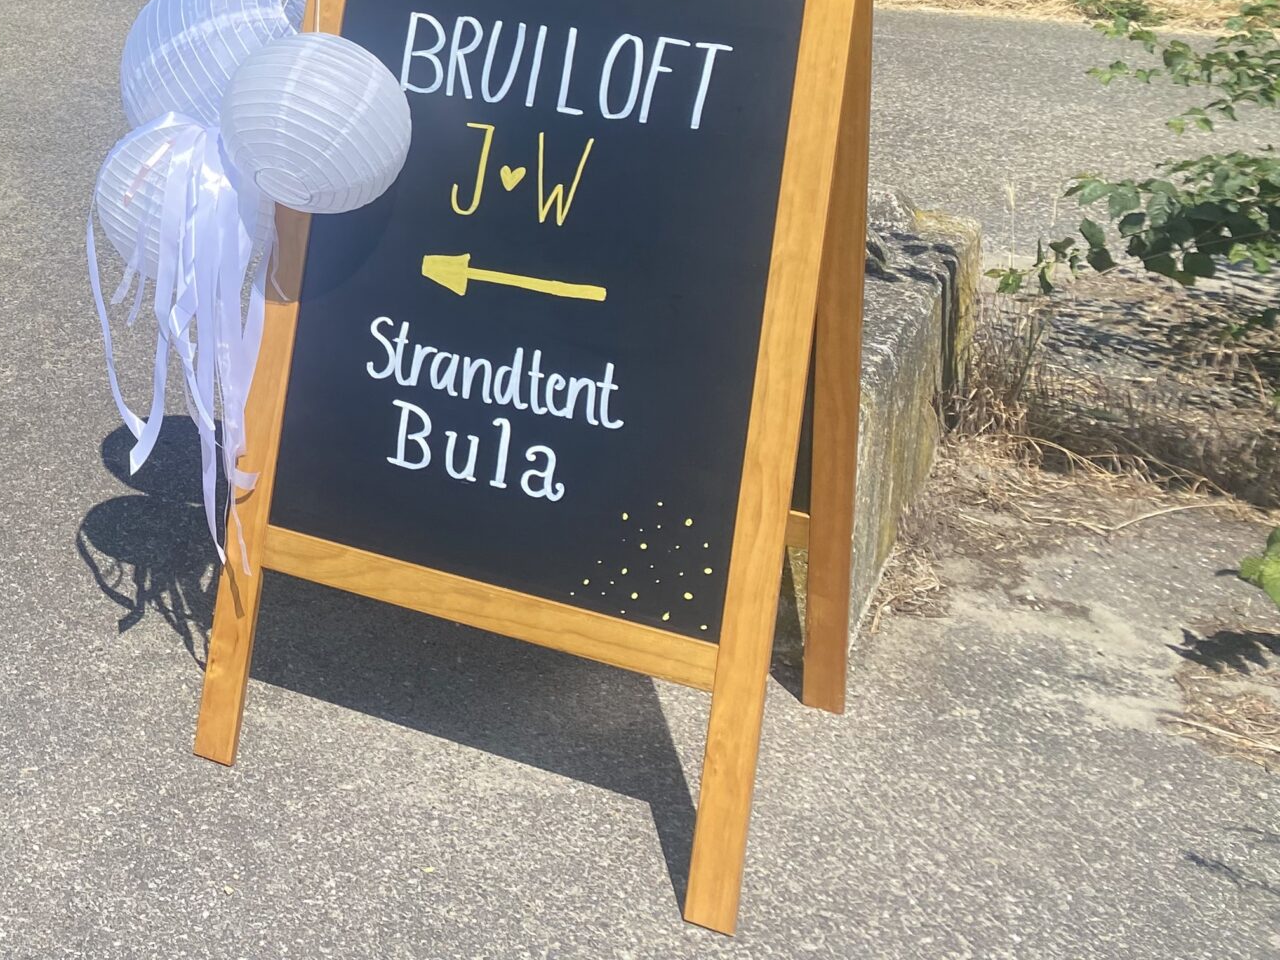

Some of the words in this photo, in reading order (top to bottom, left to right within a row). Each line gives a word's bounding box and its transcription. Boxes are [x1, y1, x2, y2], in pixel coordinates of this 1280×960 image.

[400, 11, 734, 130] BRUILOFT
[366, 316, 625, 430] Strandtent
[386, 398, 565, 503] Bula
